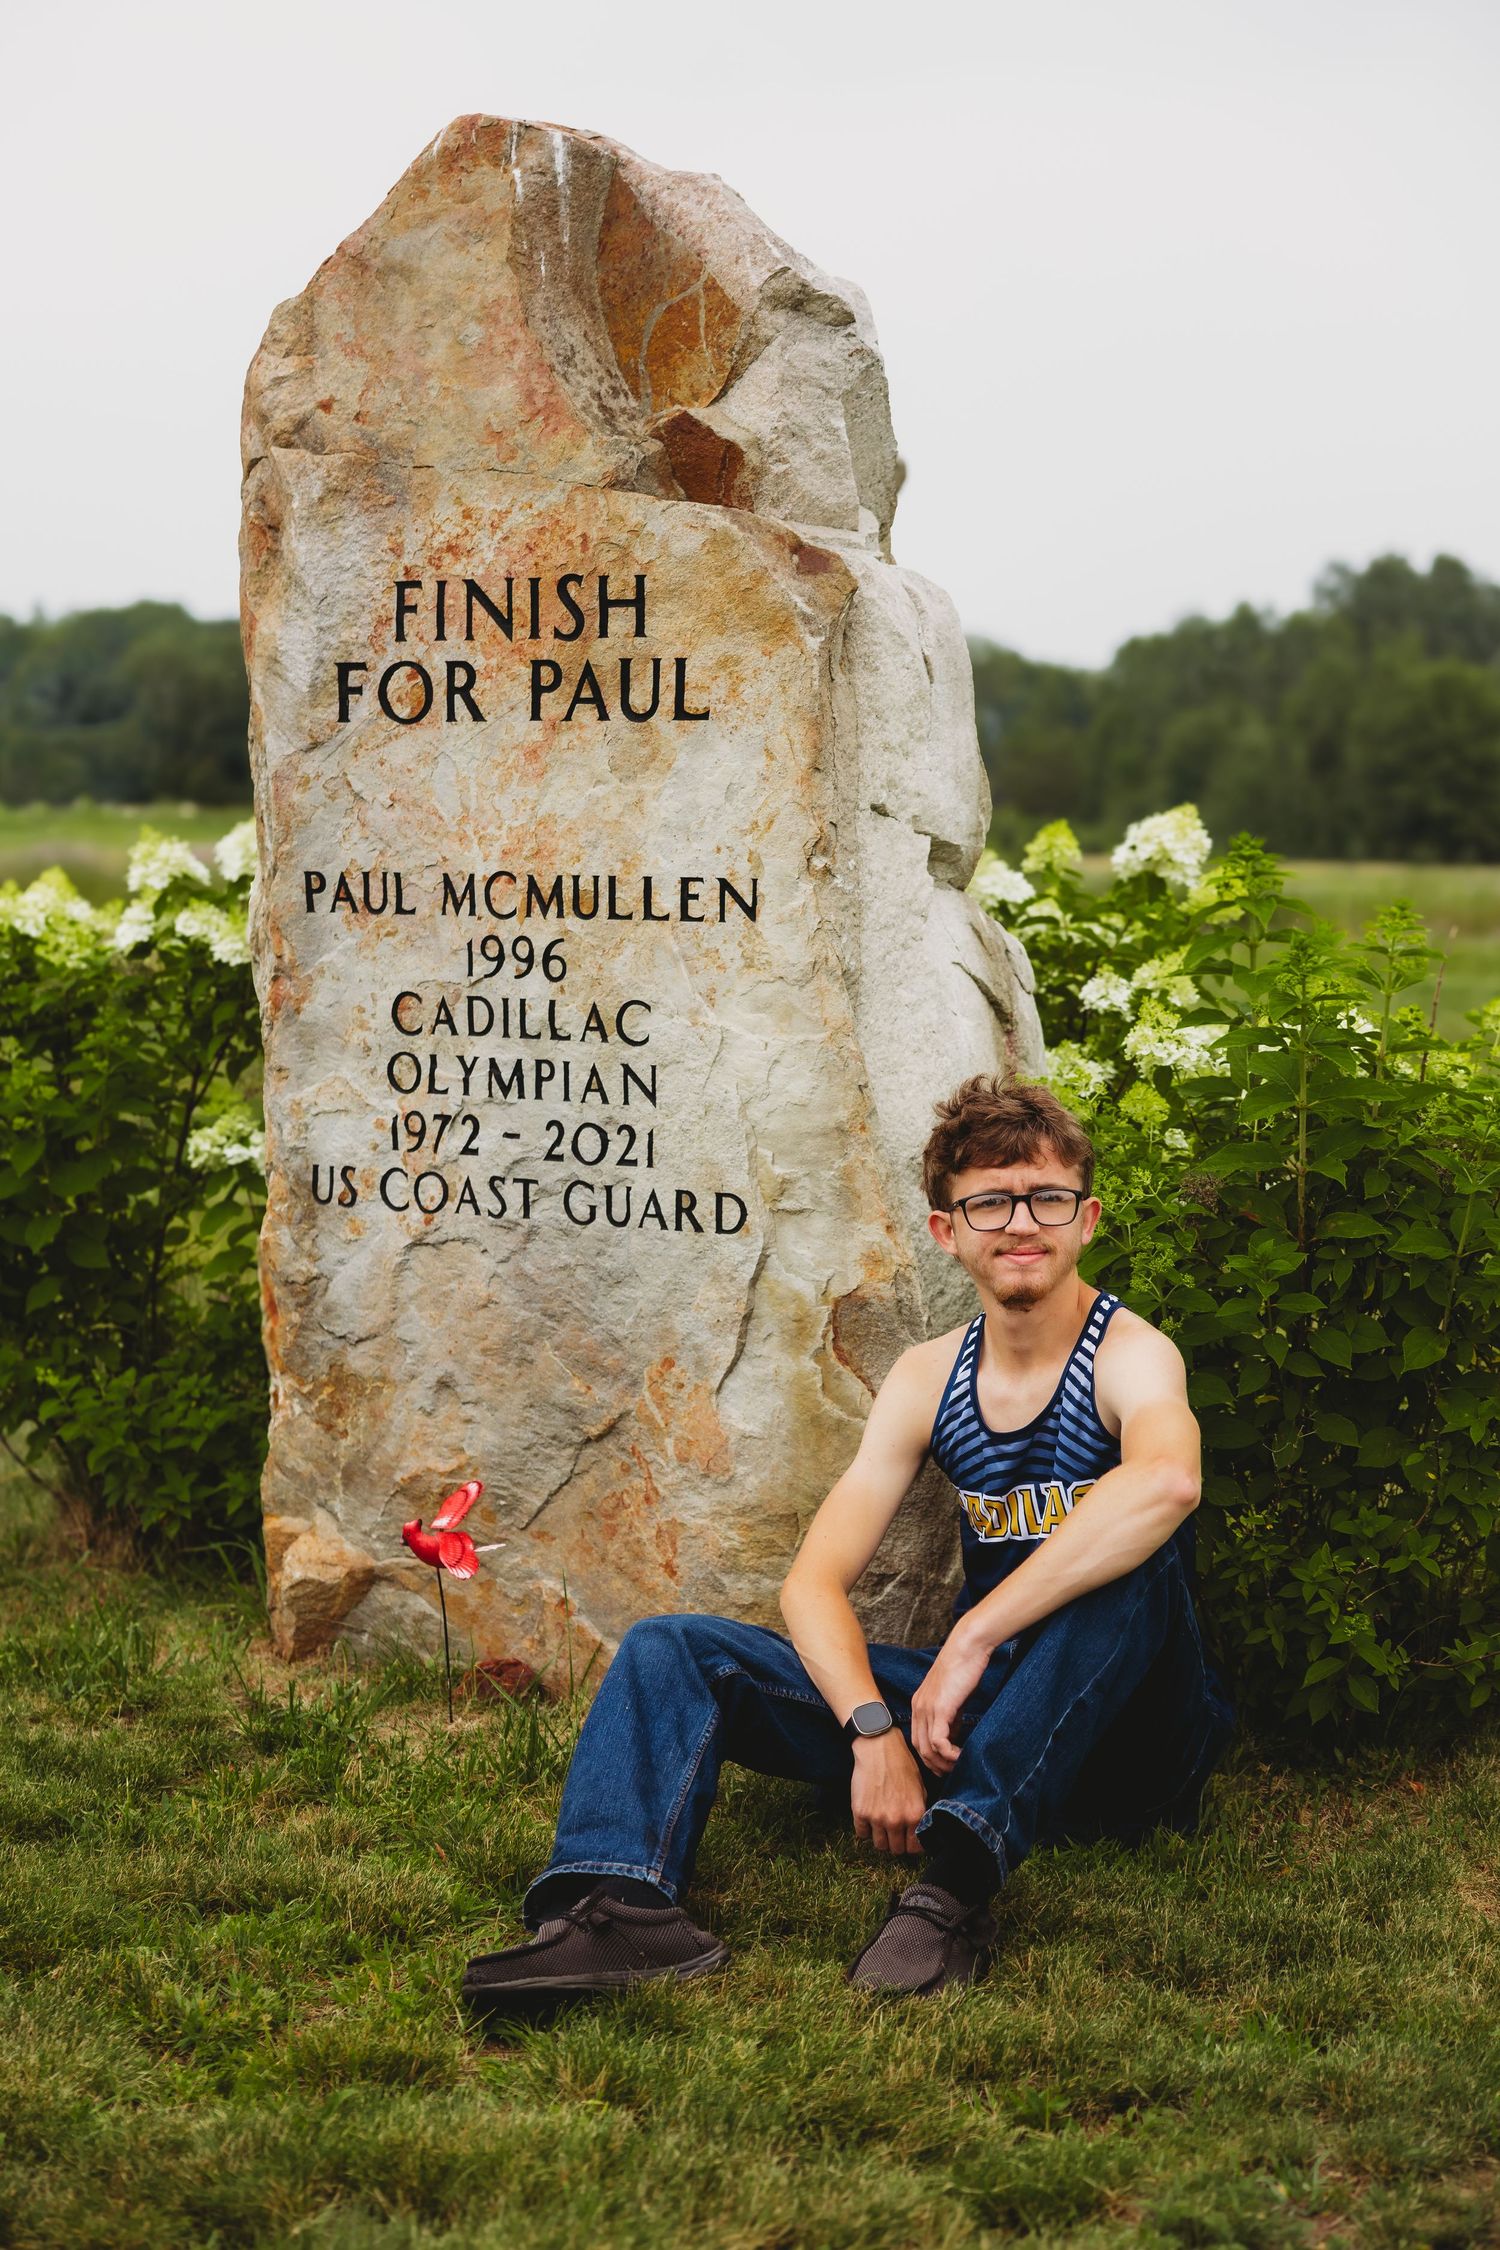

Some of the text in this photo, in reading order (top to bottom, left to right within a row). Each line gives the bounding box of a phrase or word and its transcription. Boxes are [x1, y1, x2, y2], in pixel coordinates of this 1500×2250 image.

[393, 573, 647, 643] FINISH
[334, 657, 710, 725] FOR PAUL
[303, 870, 759, 923] PAUL MCMULLEN
[466, 934, 568, 983] 1996
[391, 991, 652, 1047] CADILLAC
[386, 1051, 658, 1108] OLYMPIAN
[391, 1110, 655, 1168] 1972 - 2021
[311, 1164, 748, 1235] US COAST GUARD
